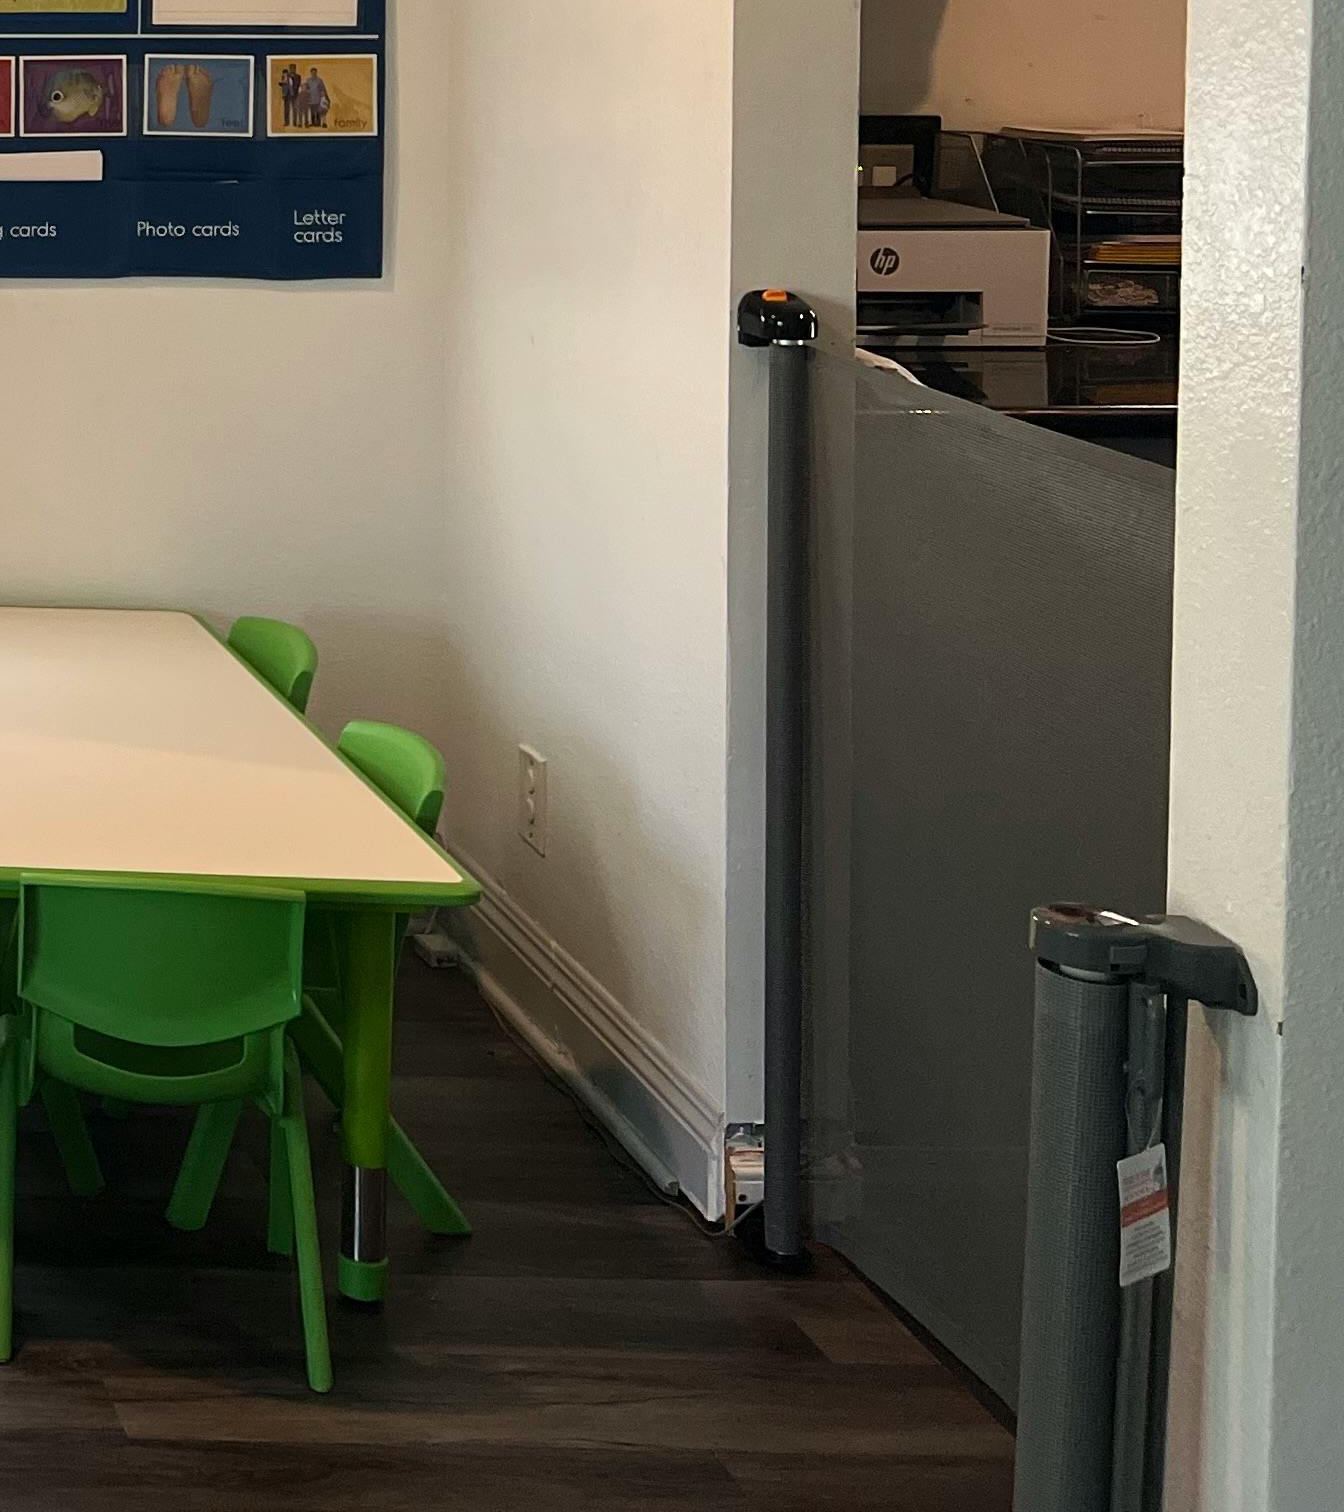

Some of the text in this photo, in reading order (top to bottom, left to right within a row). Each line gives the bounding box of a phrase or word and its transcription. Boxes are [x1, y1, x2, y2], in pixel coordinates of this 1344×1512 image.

[333, 117, 369, 129] family
[293, 209, 346, 226] Letter
[9, 221, 57, 239] cards
[136, 220, 240, 239] Photo cards
[293, 226, 343, 244] cards
[871, 246, 899, 276] hp
